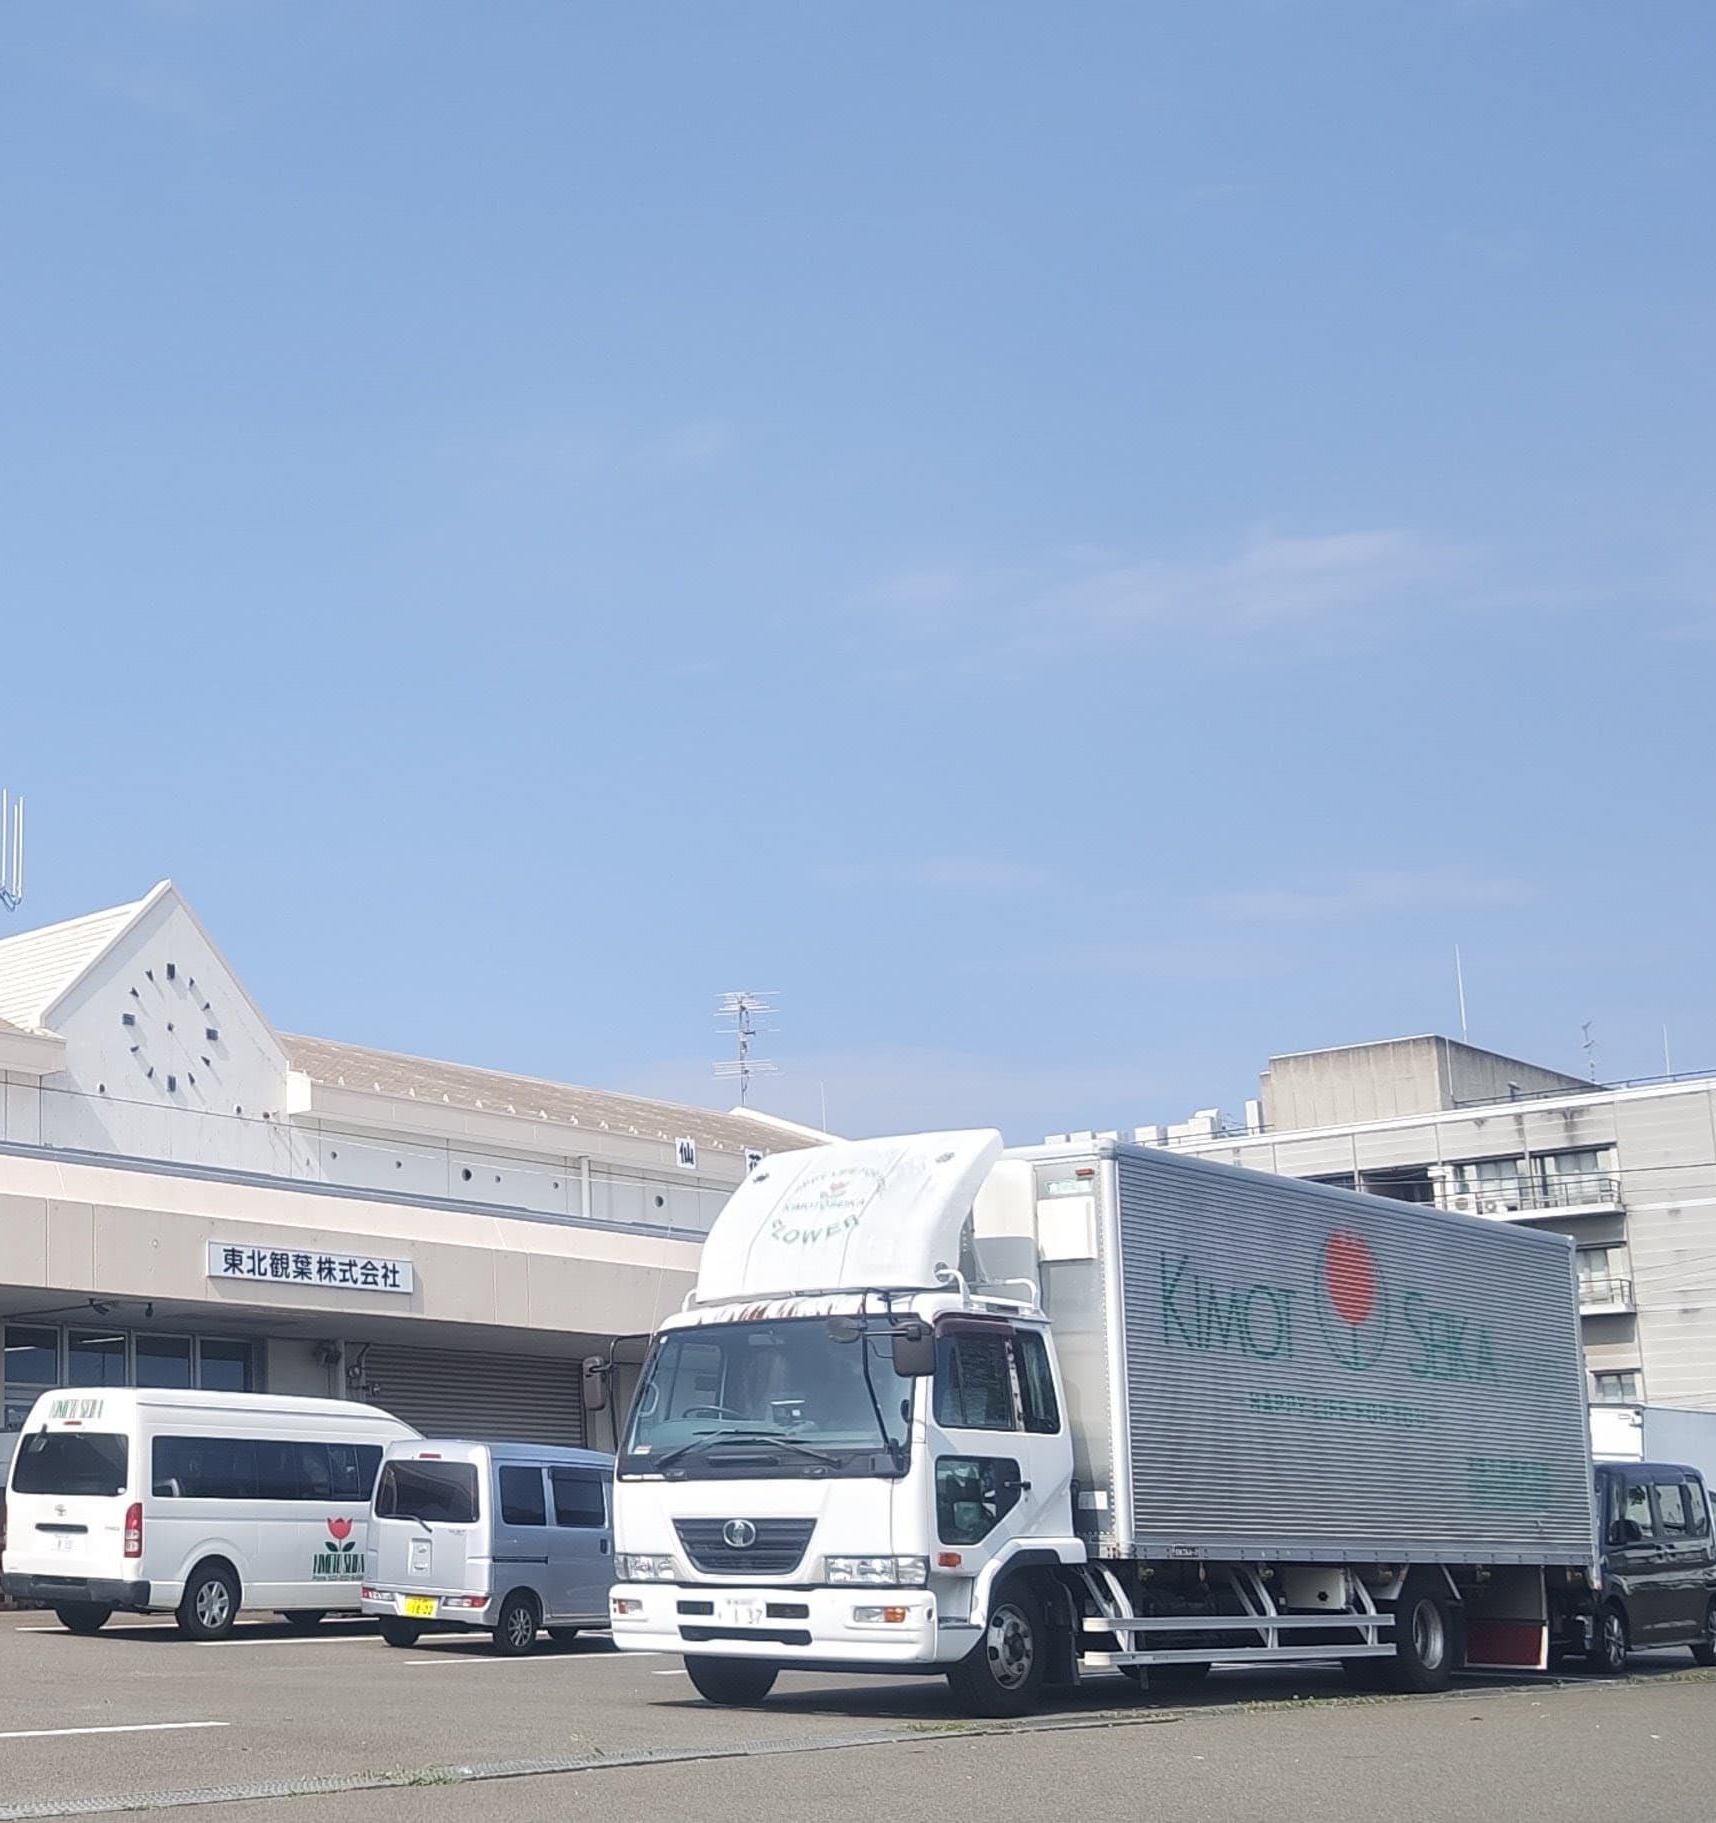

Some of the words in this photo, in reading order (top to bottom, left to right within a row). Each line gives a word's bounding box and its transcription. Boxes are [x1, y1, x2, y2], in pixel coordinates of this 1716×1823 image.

[222, 1247, 401, 1288] 東北観葉株式会社
